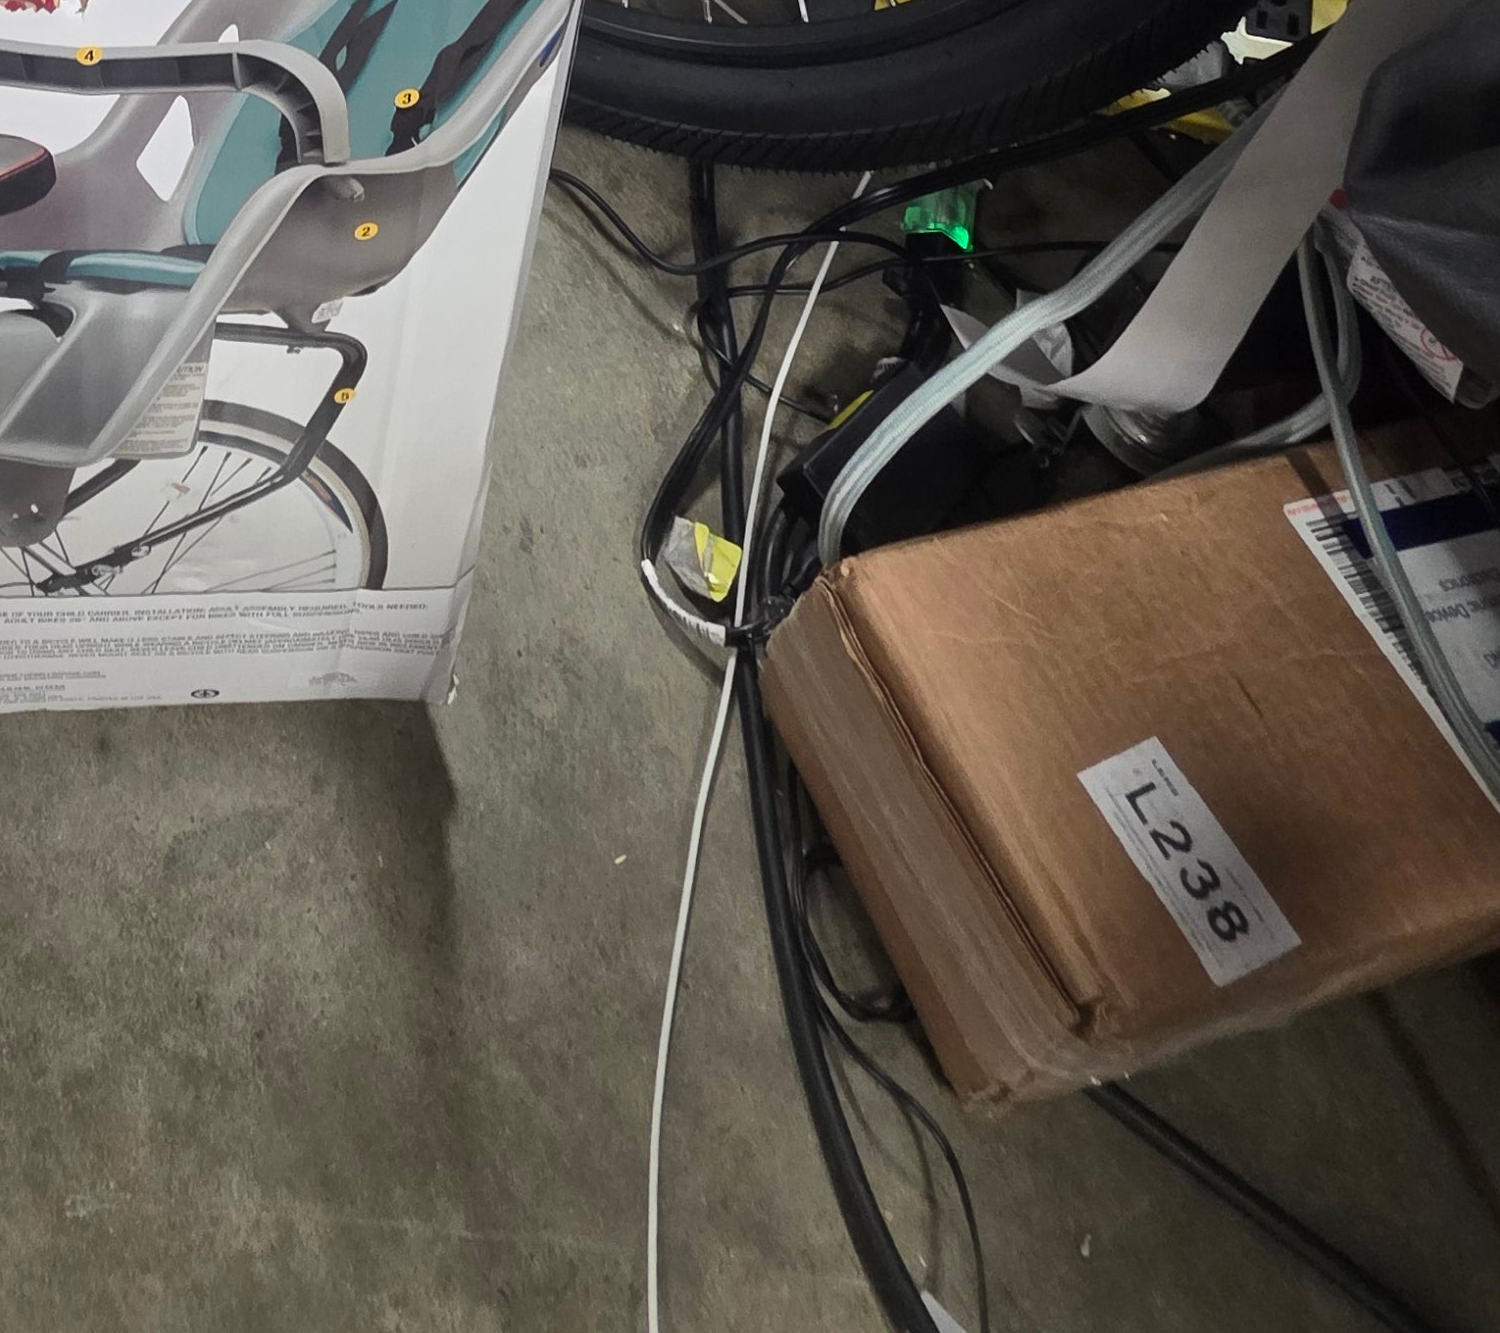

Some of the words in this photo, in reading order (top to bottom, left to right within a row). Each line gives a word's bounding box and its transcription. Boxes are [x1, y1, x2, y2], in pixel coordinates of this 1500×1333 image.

[84, 49, 94, 62] 4
[402, 93, 412, 105] 3
[361, 226, 371, 238] 2
[1124, 781, 1249, 943] L238
